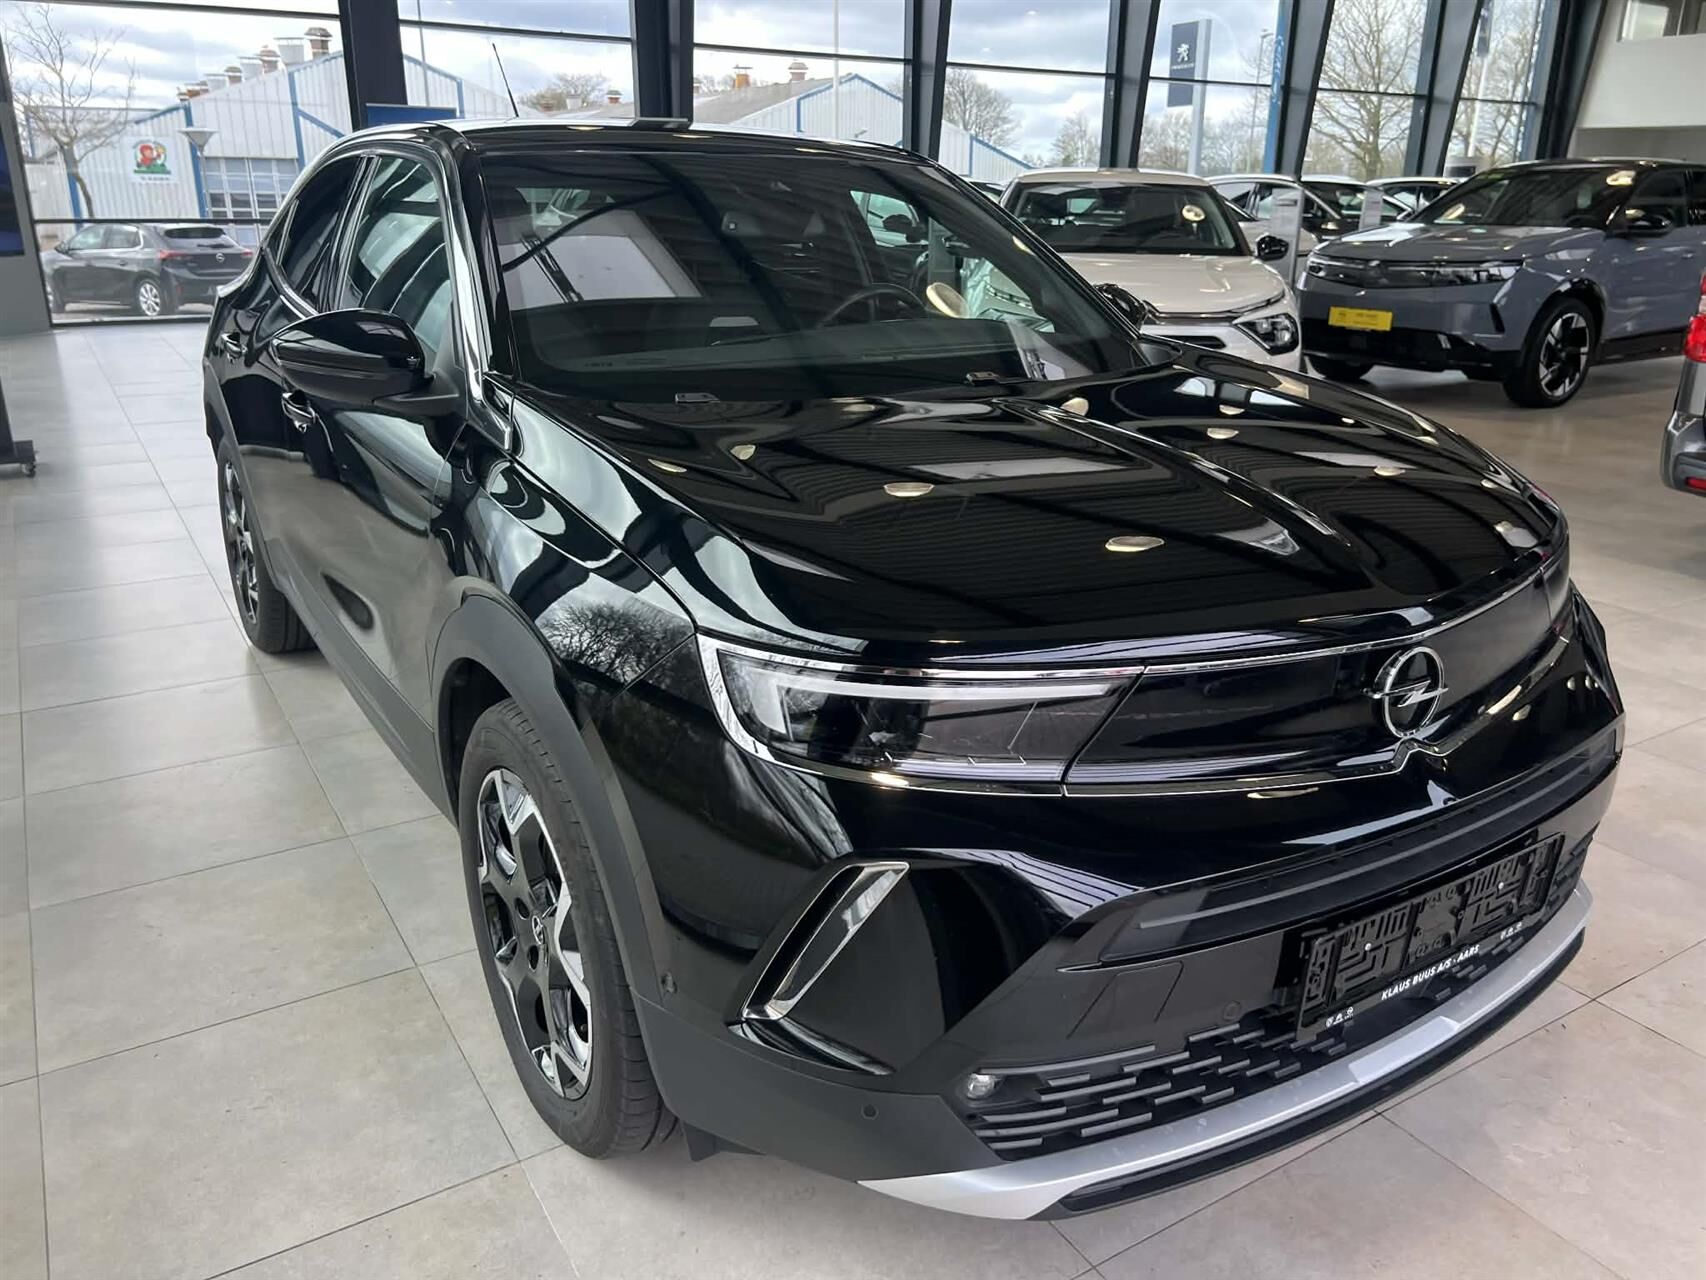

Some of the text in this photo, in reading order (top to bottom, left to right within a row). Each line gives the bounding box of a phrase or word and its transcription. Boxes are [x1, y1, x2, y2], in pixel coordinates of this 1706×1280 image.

[1381, 979, 1411, 1001] KLAUS
[1412, 966, 1436, 986] BUUS
[1436, 958, 1452, 973] A/S
[1457, 944, 1480, 963] AARS
